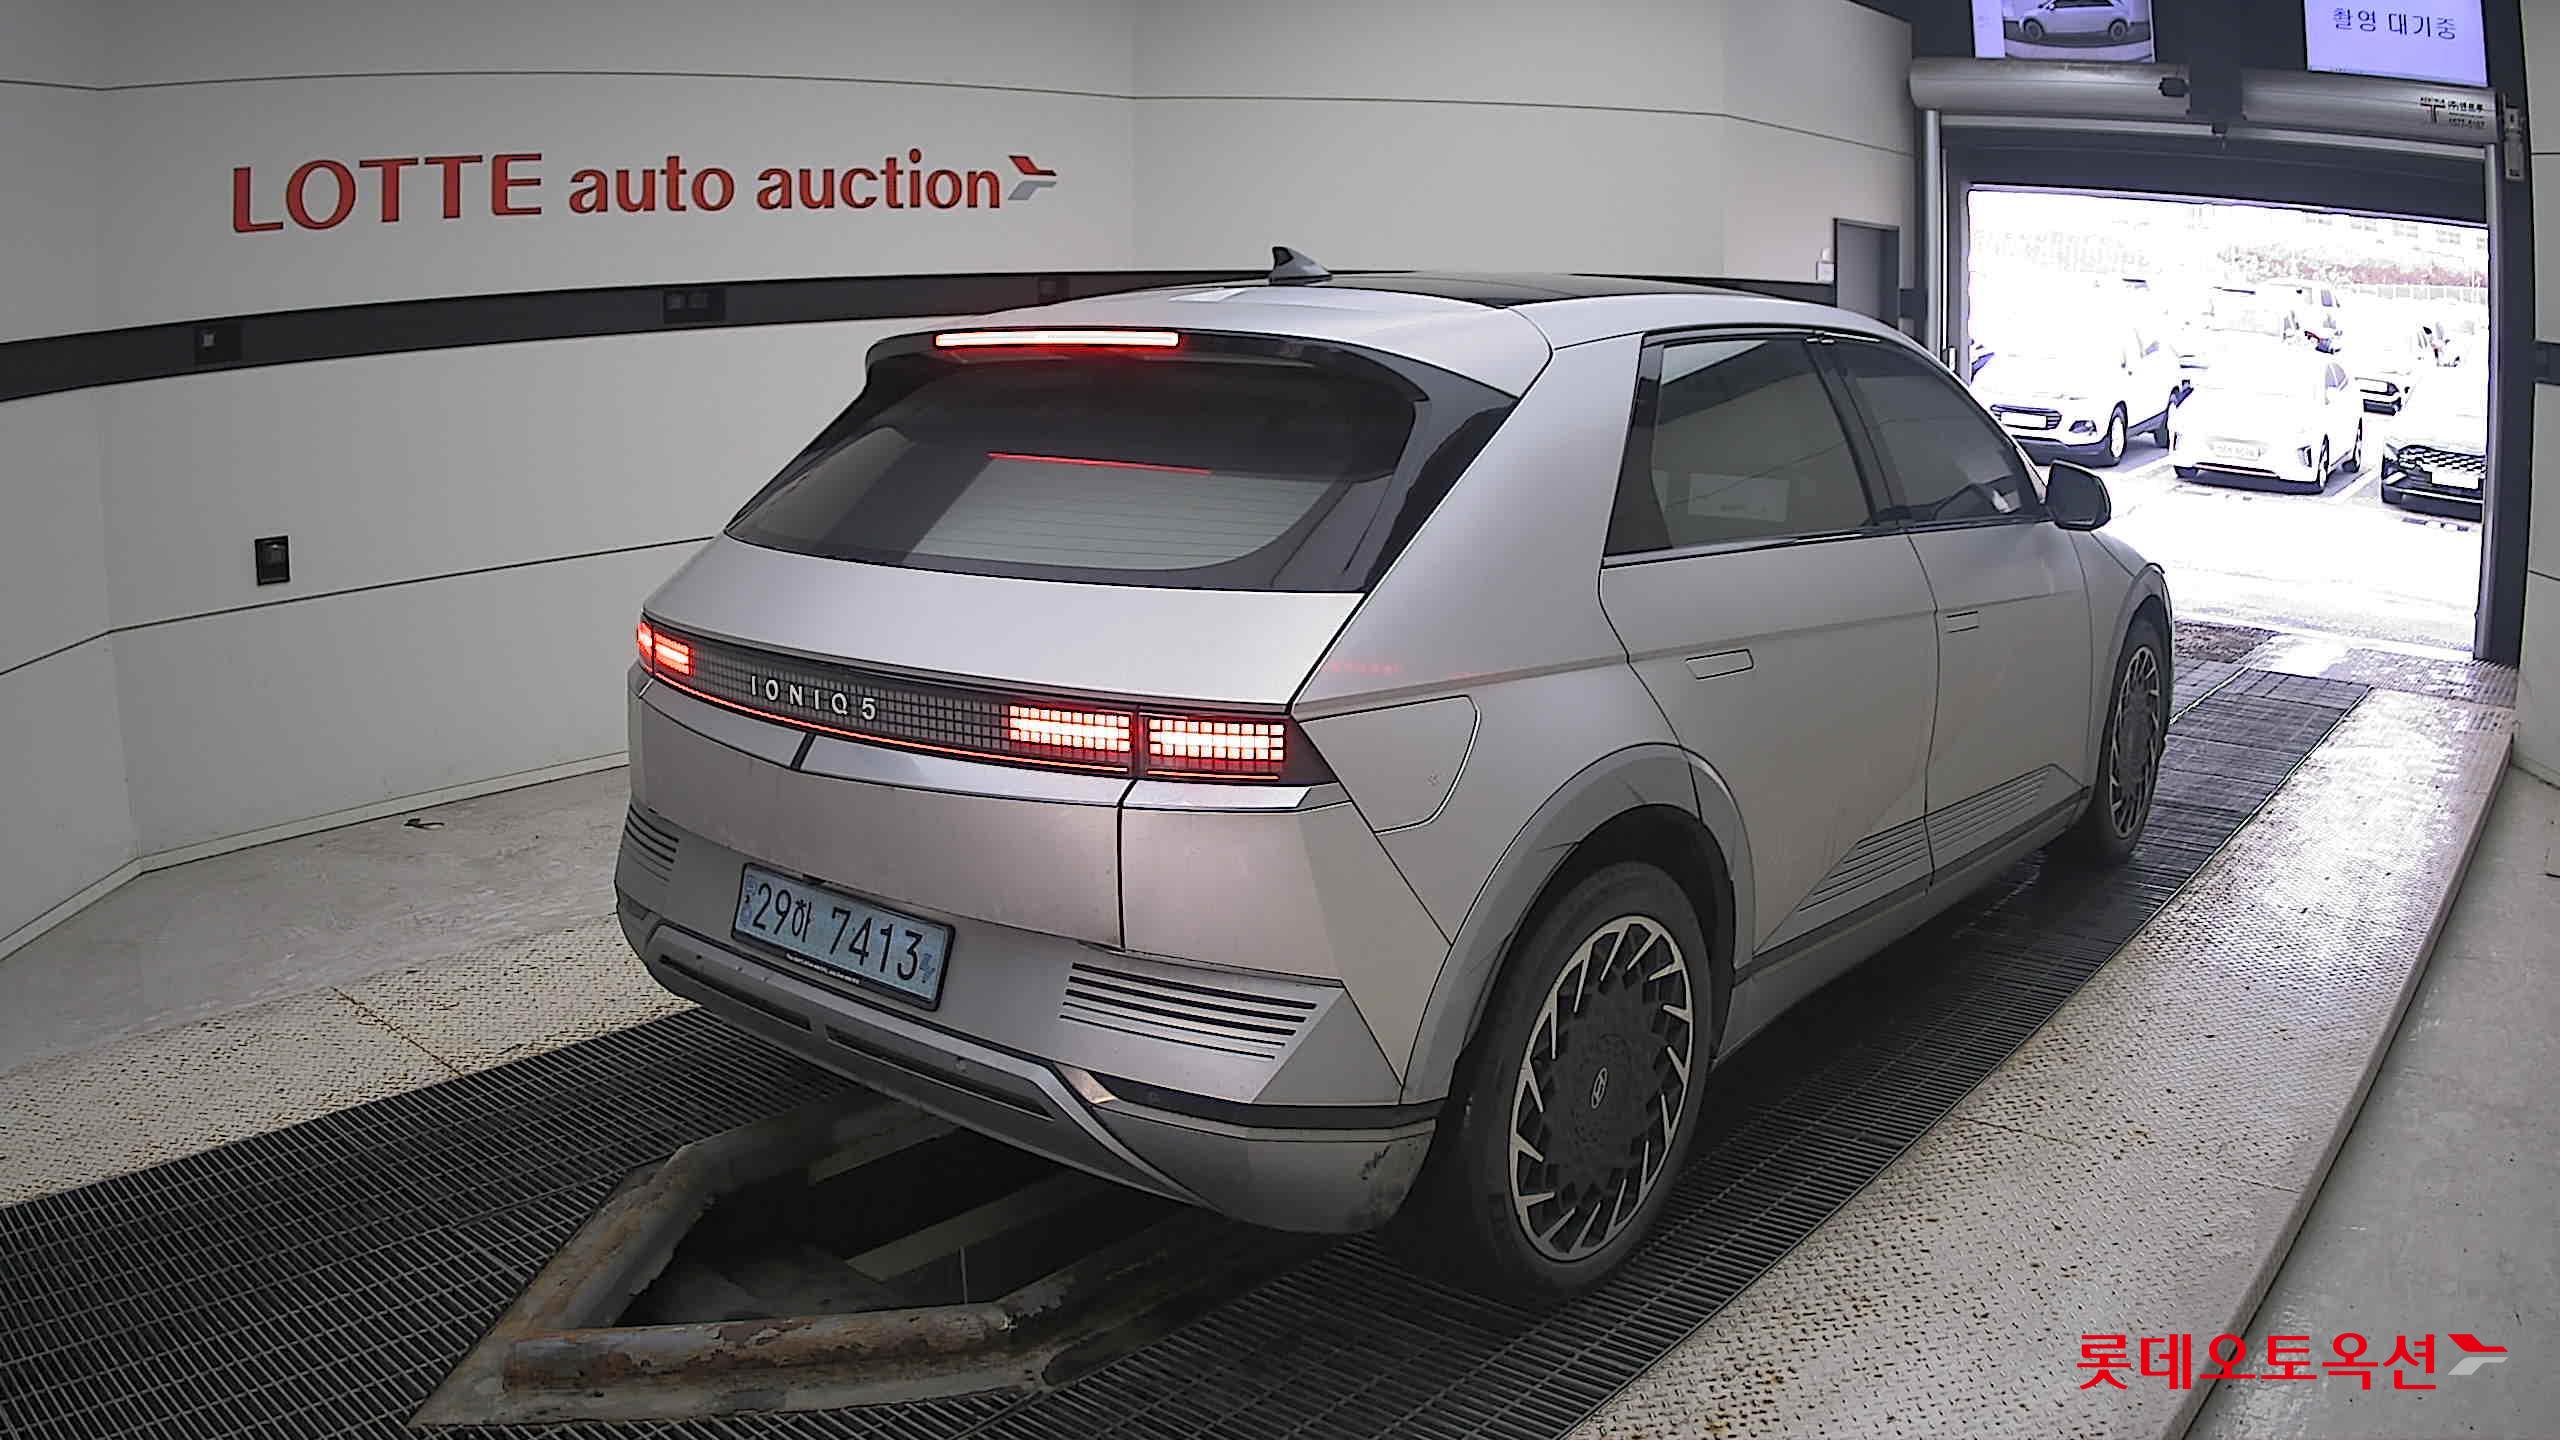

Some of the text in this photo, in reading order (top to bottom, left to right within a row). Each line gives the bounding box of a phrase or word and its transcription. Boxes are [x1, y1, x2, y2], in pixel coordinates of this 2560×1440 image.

[2334, 8, 2456, 40] 촬영 대기중
[233, 148, 1000, 233] LOTTE auto auction
[751, 675, 876, 720] IONIQ 5
[752, 882, 812, 943] 29하
[830, 906, 924, 981] 7413
